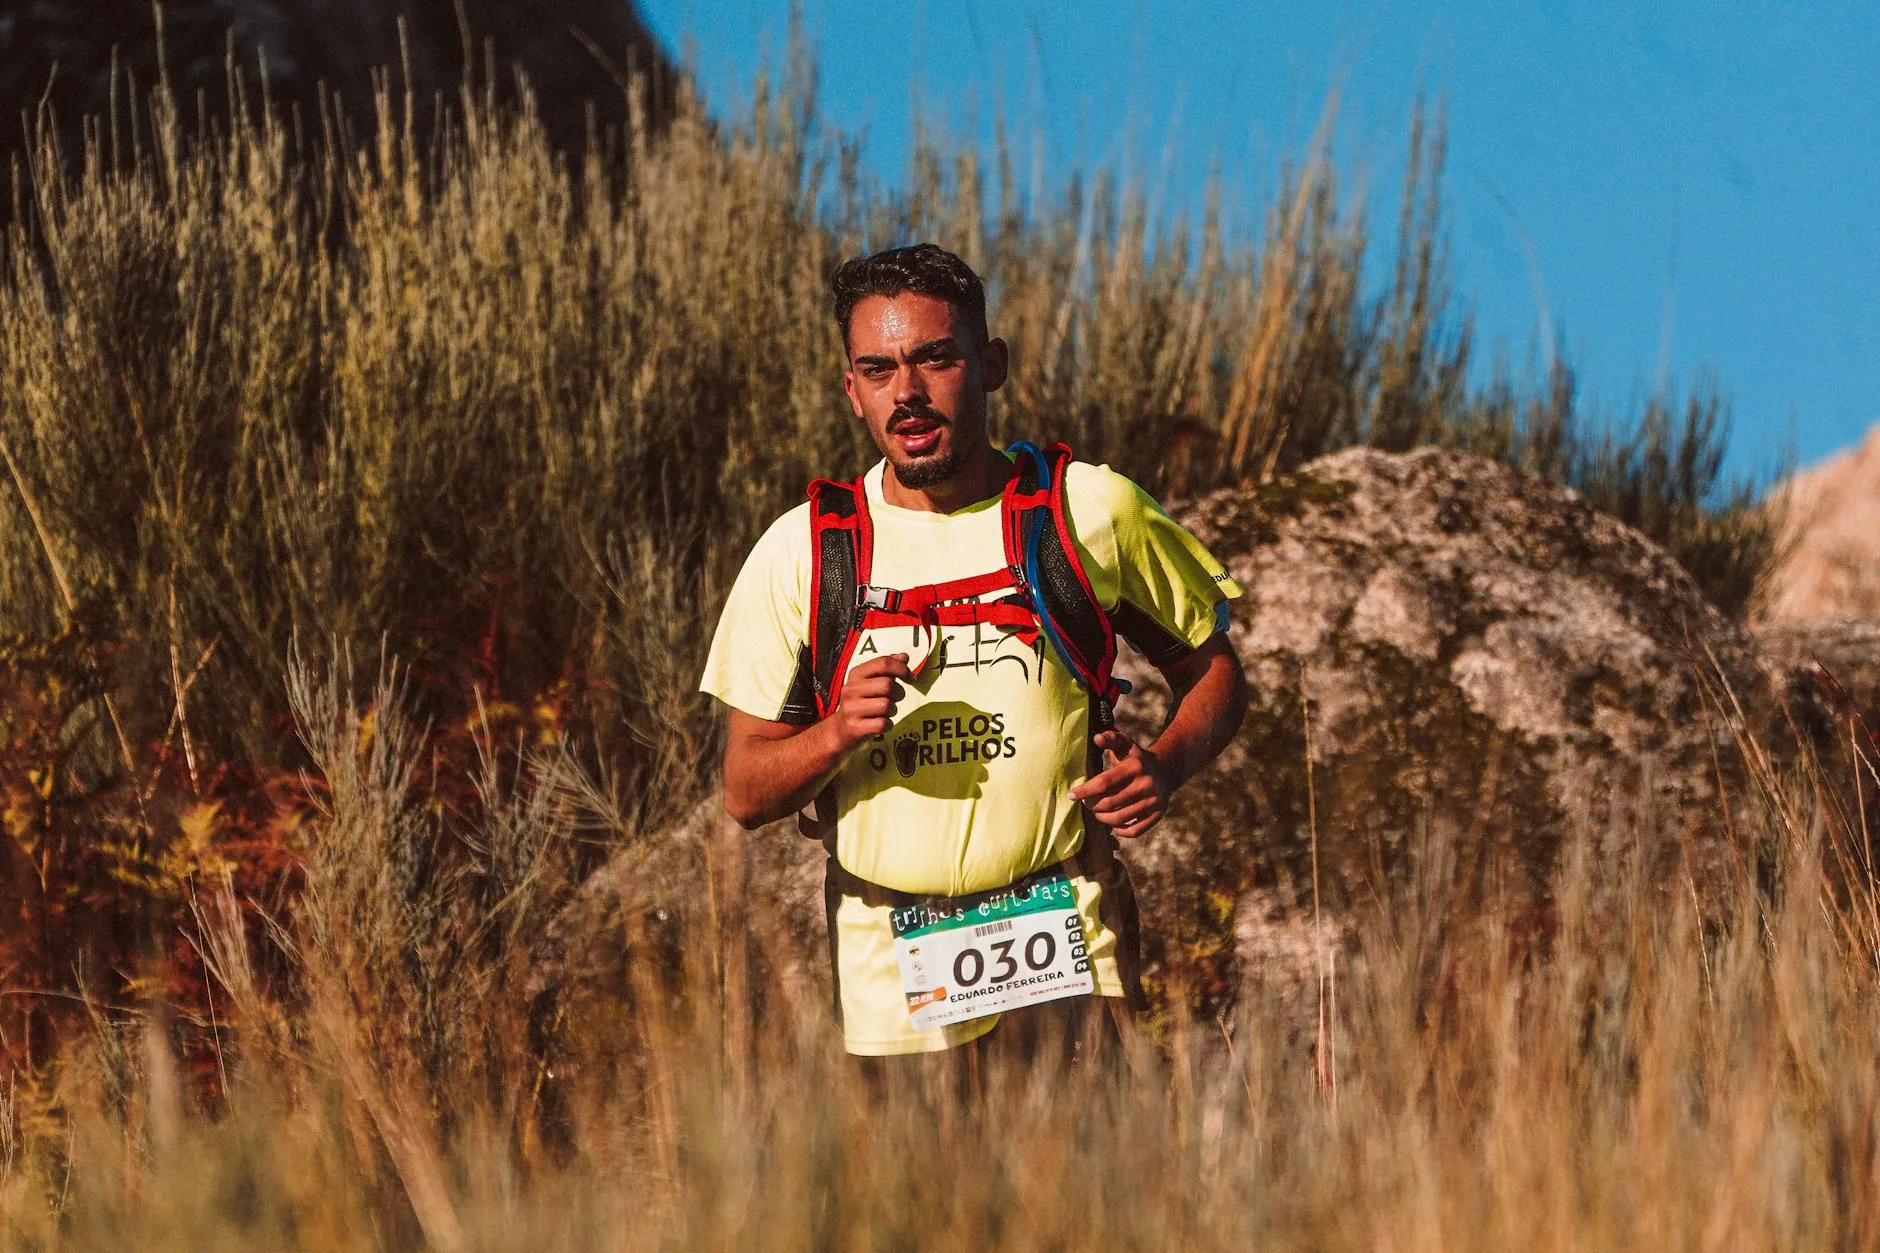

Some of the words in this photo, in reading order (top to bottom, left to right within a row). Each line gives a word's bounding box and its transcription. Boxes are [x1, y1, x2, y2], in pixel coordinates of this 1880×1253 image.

[923, 713, 1005, 741] PELOS
[1067, 918, 1078, 927] 01
[1070, 932, 1081, 941] 02
[1073, 947, 1084, 956] 03
[953, 931, 1057, 987] 030
[1076, 962, 1088, 971] 04
[950, 985, 1004, 1003] EDUARDO
[1006, 970, 1065, 991] FERREIRA
